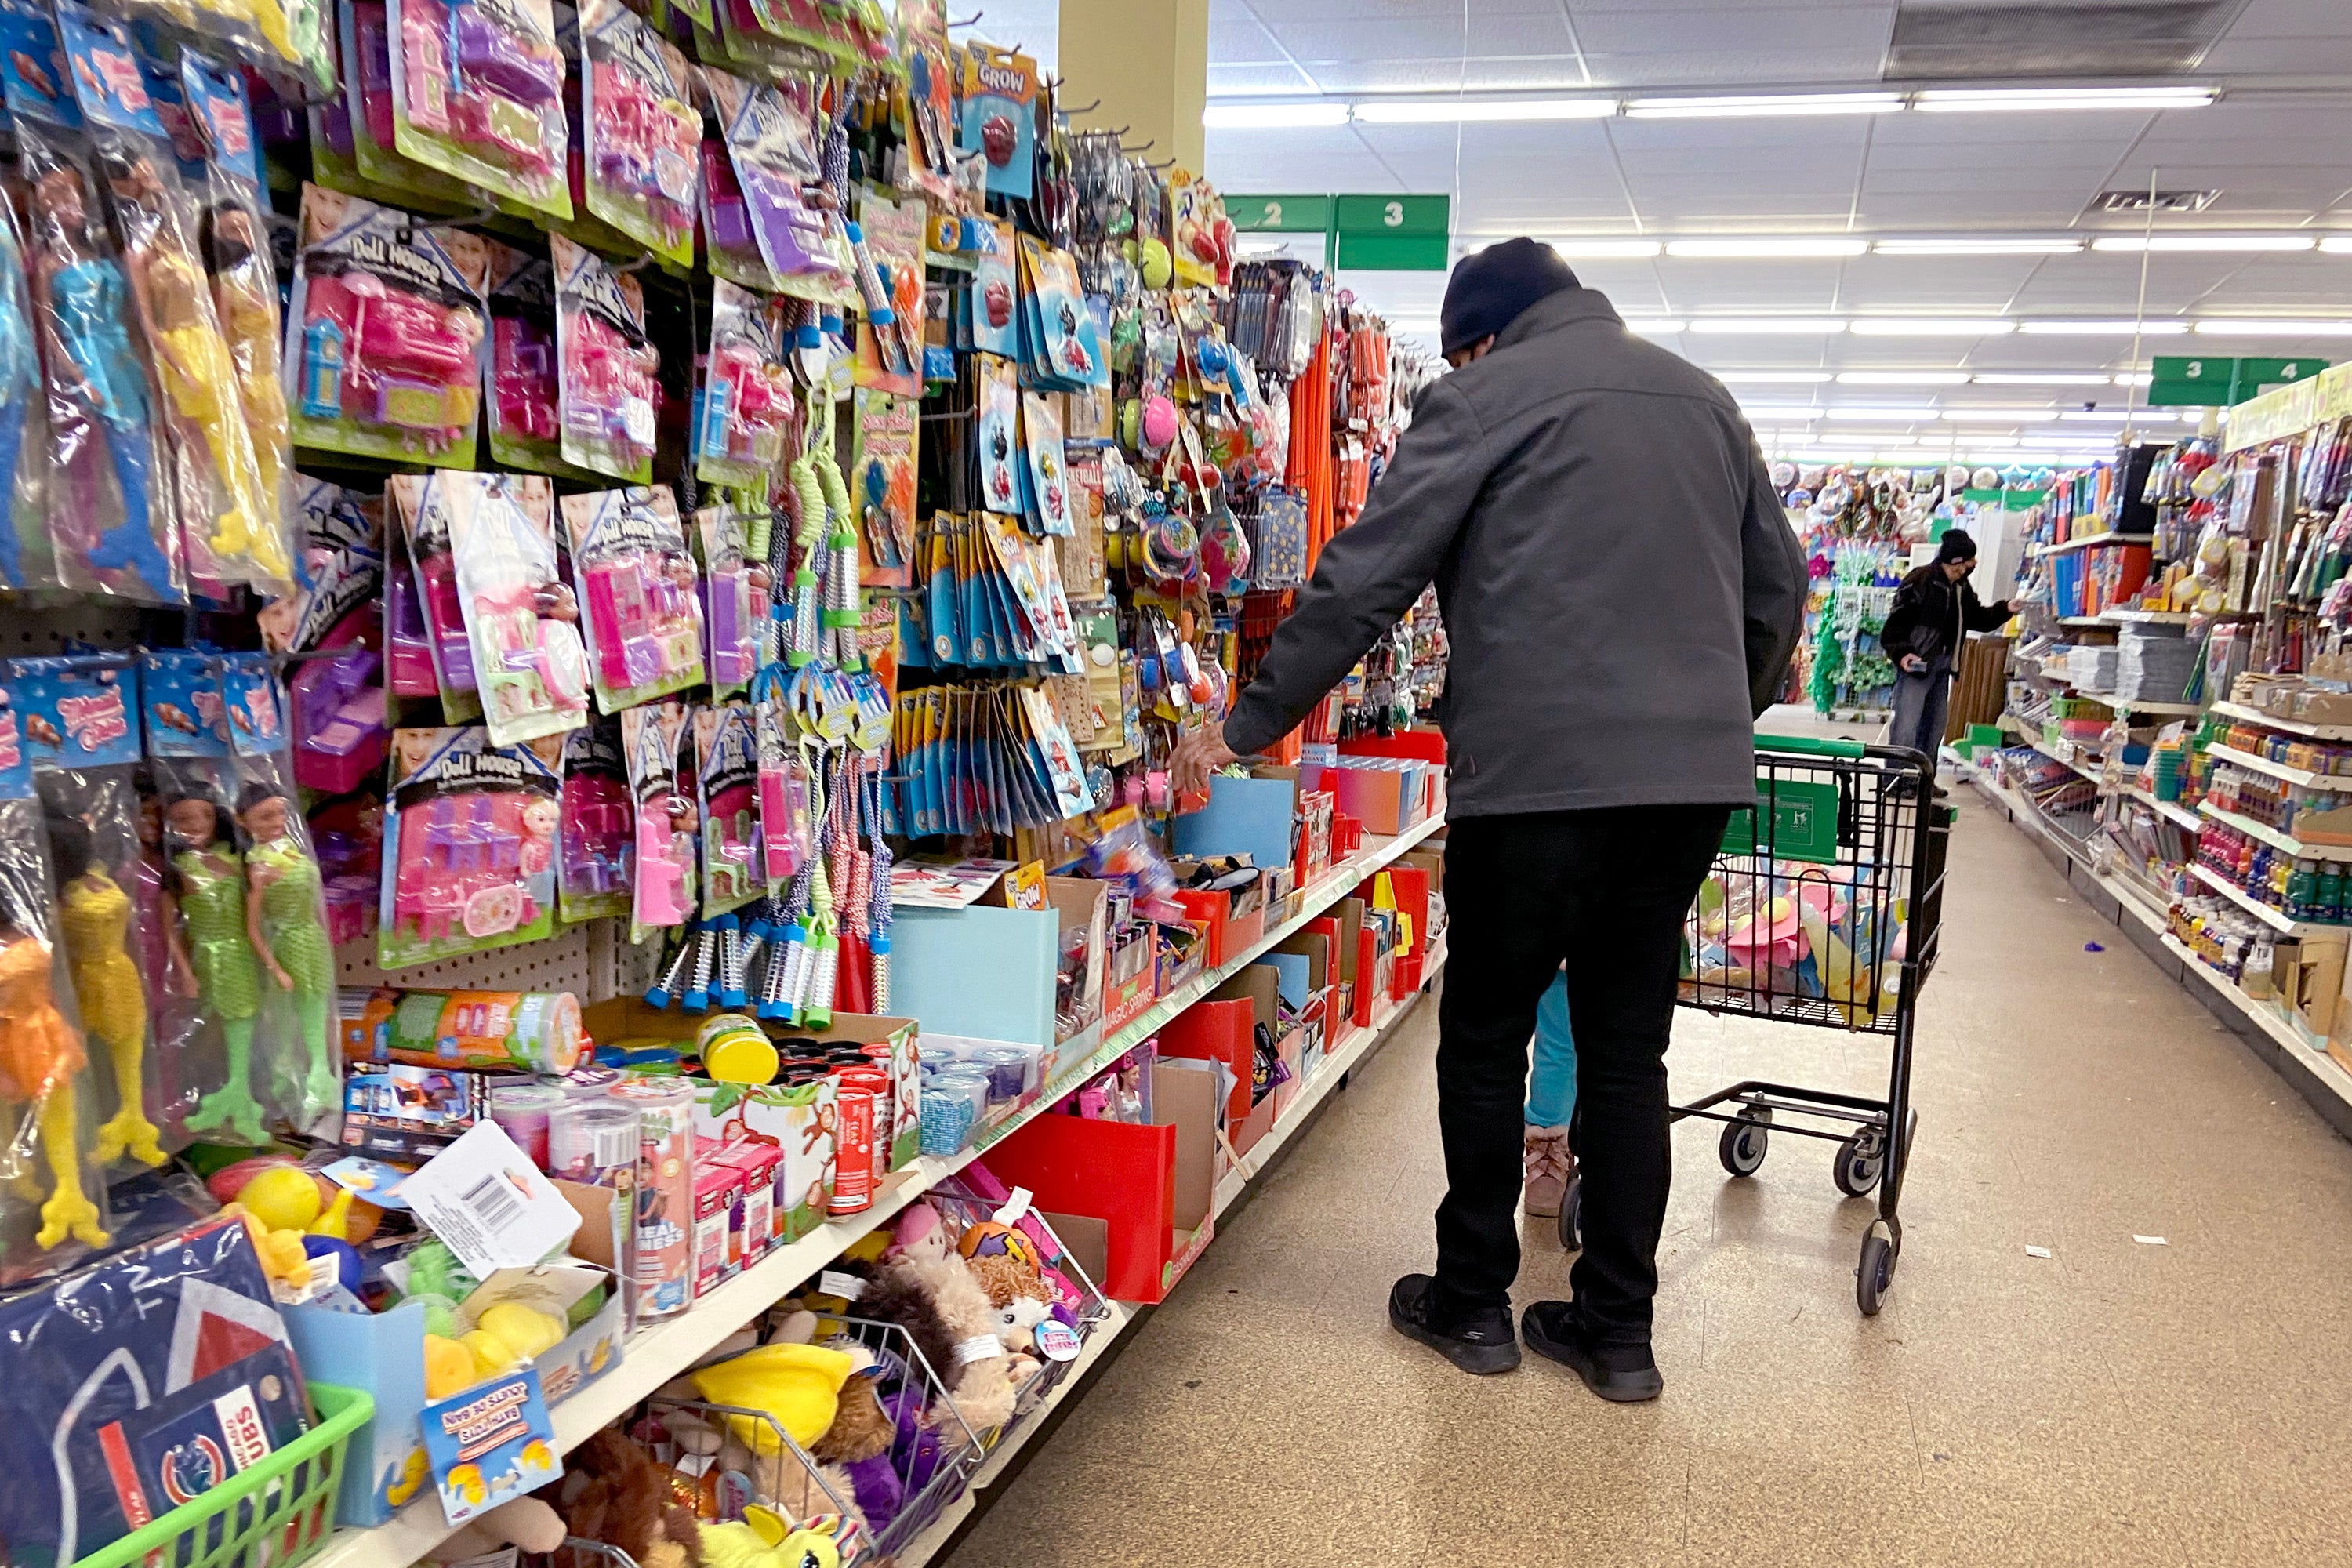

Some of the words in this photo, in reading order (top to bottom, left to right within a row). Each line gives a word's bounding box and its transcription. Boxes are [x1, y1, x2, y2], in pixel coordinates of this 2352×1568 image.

[978, 65, 1025, 93] GROW
[1264, 201, 1282, 227] 2
[1384, 201, 1404, 227] 3
[2187, 361, 2202, 379] 3
[2281, 362, 2298, 379] 4
[998, 534, 1021, 559] GROW
[1014, 883, 1041, 909] GROW
[226, 1419, 249, 1470] HICAGO
[235, 1405, 265, 1461] UBS
